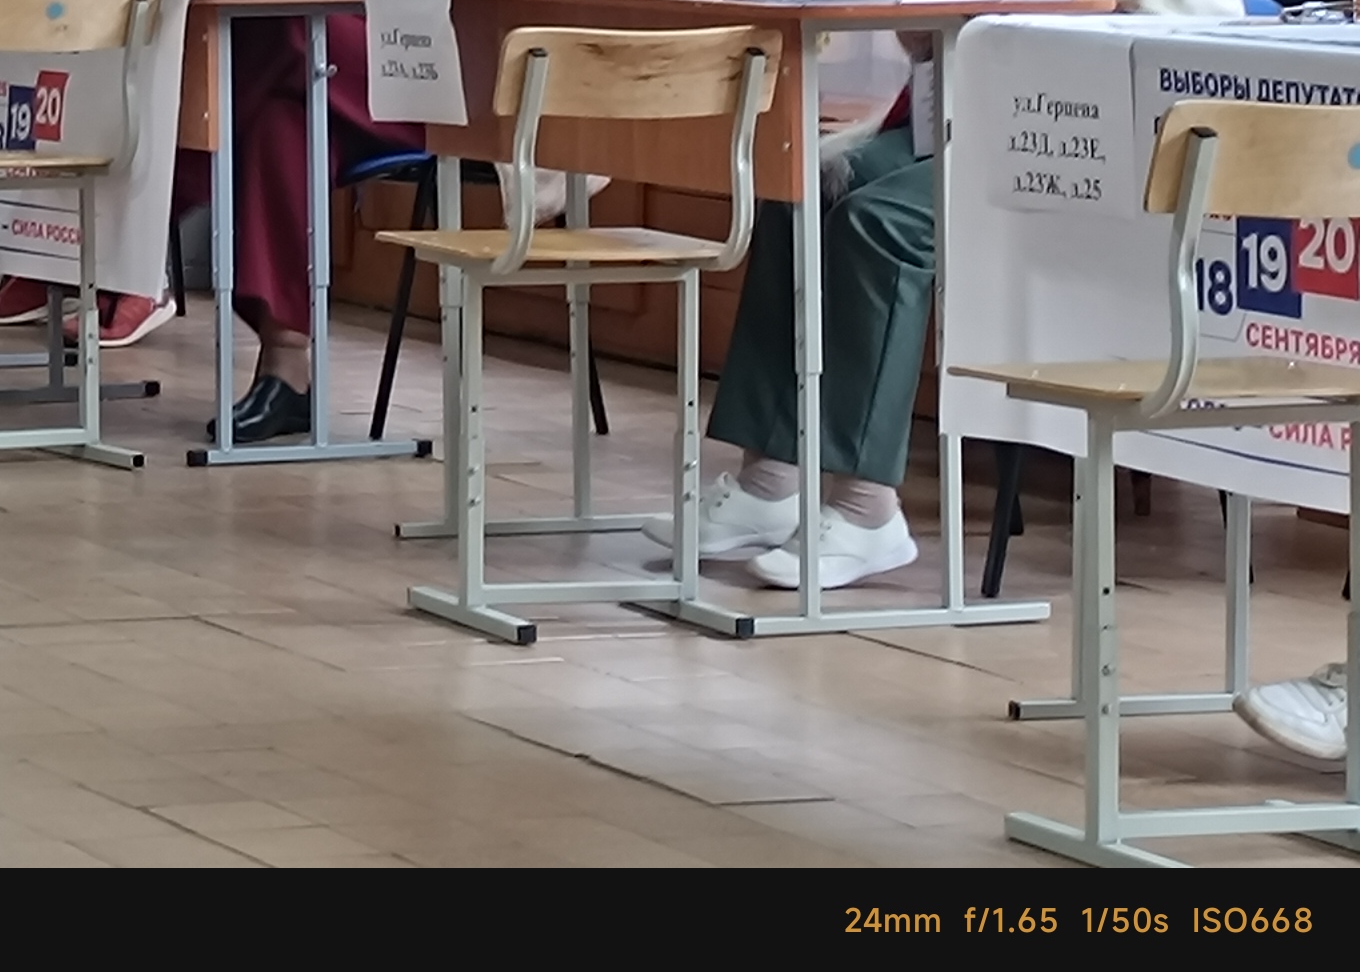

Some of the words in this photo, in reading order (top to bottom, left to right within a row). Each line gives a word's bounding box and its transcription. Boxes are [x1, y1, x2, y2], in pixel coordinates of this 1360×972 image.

[1159, 66, 1250, 101] ВЫБОРЫ
[10, 103, 32, 141] 19
[36, 87, 60, 126] 20
[1240, 231, 1288, 293] 19
[1298, 217, 1356, 274] 20
